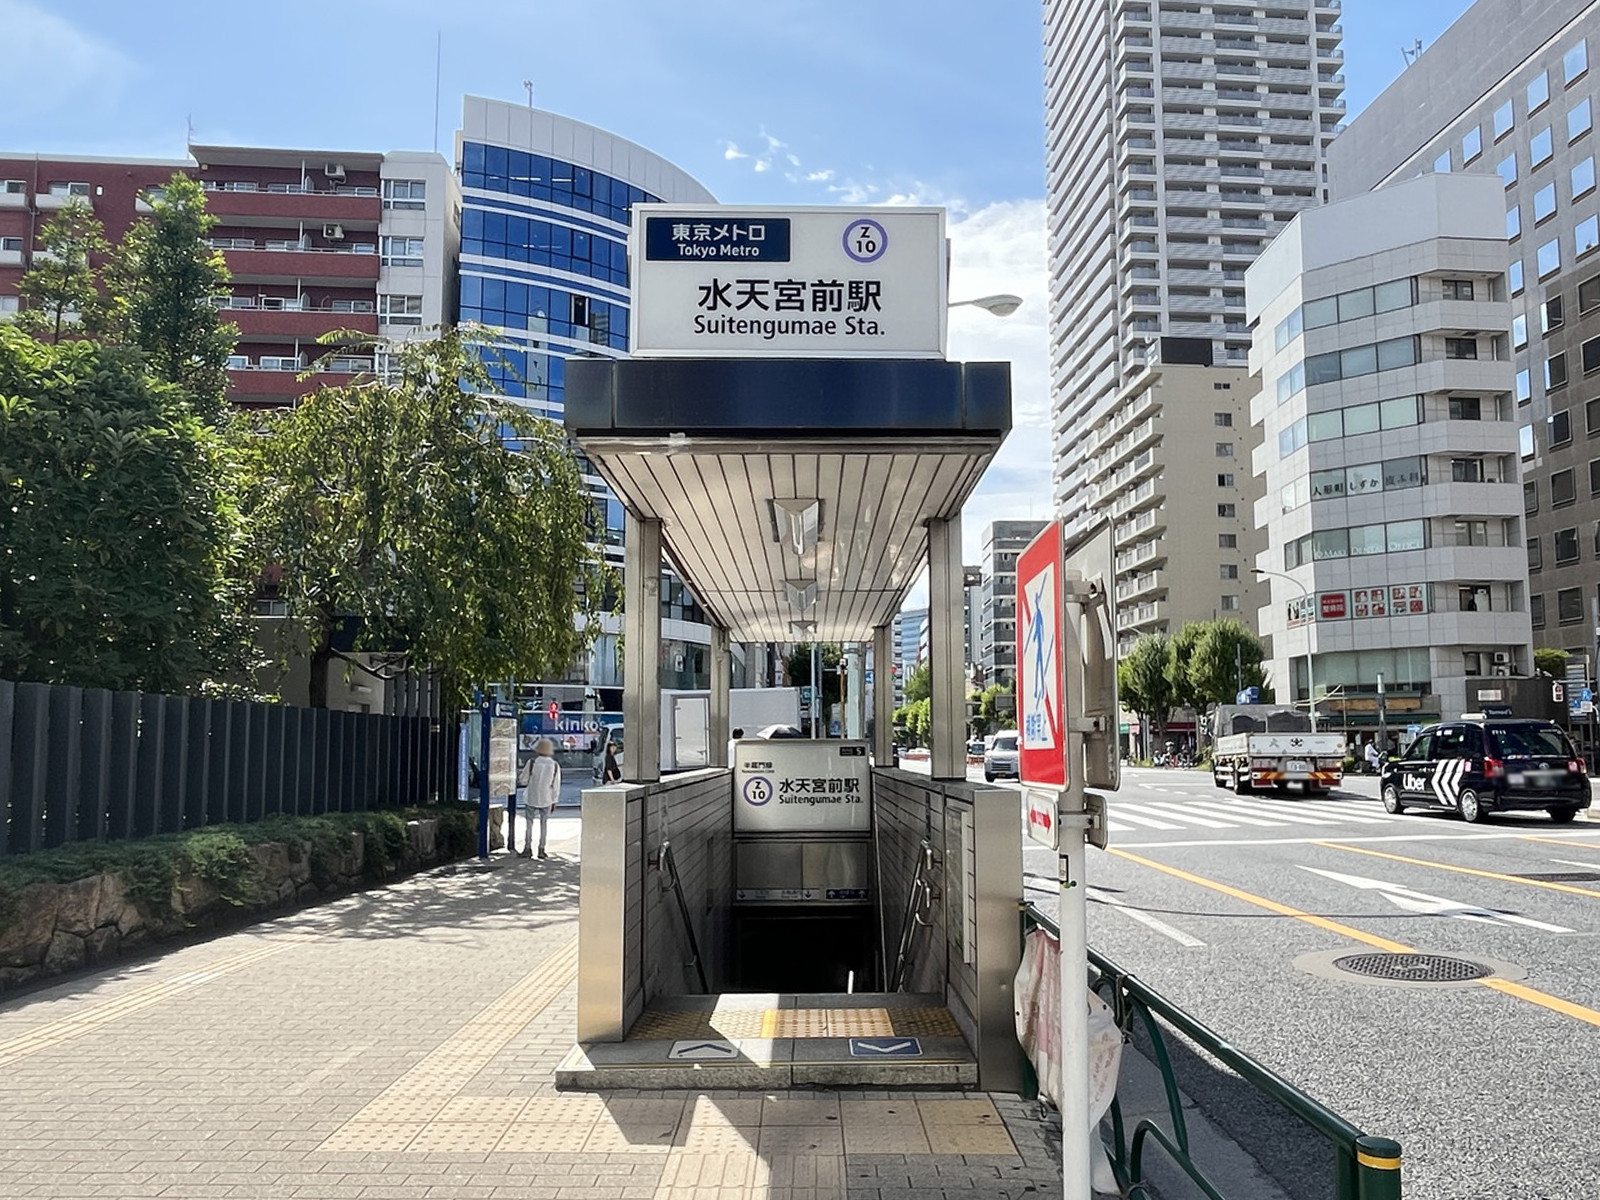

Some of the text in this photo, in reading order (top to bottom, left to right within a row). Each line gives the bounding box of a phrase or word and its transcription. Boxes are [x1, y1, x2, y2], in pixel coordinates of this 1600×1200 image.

[672, 223, 765, 241] 東京メトロ
[860, 226, 870, 238] Z
[677, 244, 760, 258] Tokyo Metro
[856, 240, 876, 254] 10
[698, 278, 882, 313] 水天宮前駅
[694, 315, 886, 340] Suitengumae Sta.
[754, 781, 762, 790] Z
[779, 778, 860, 793] 水天宮前駅
[1402, 773, 1426, 791] Uber
[752, 791, 766, 800] 10
[779, 794, 864, 806] Suitengumae Sta.
